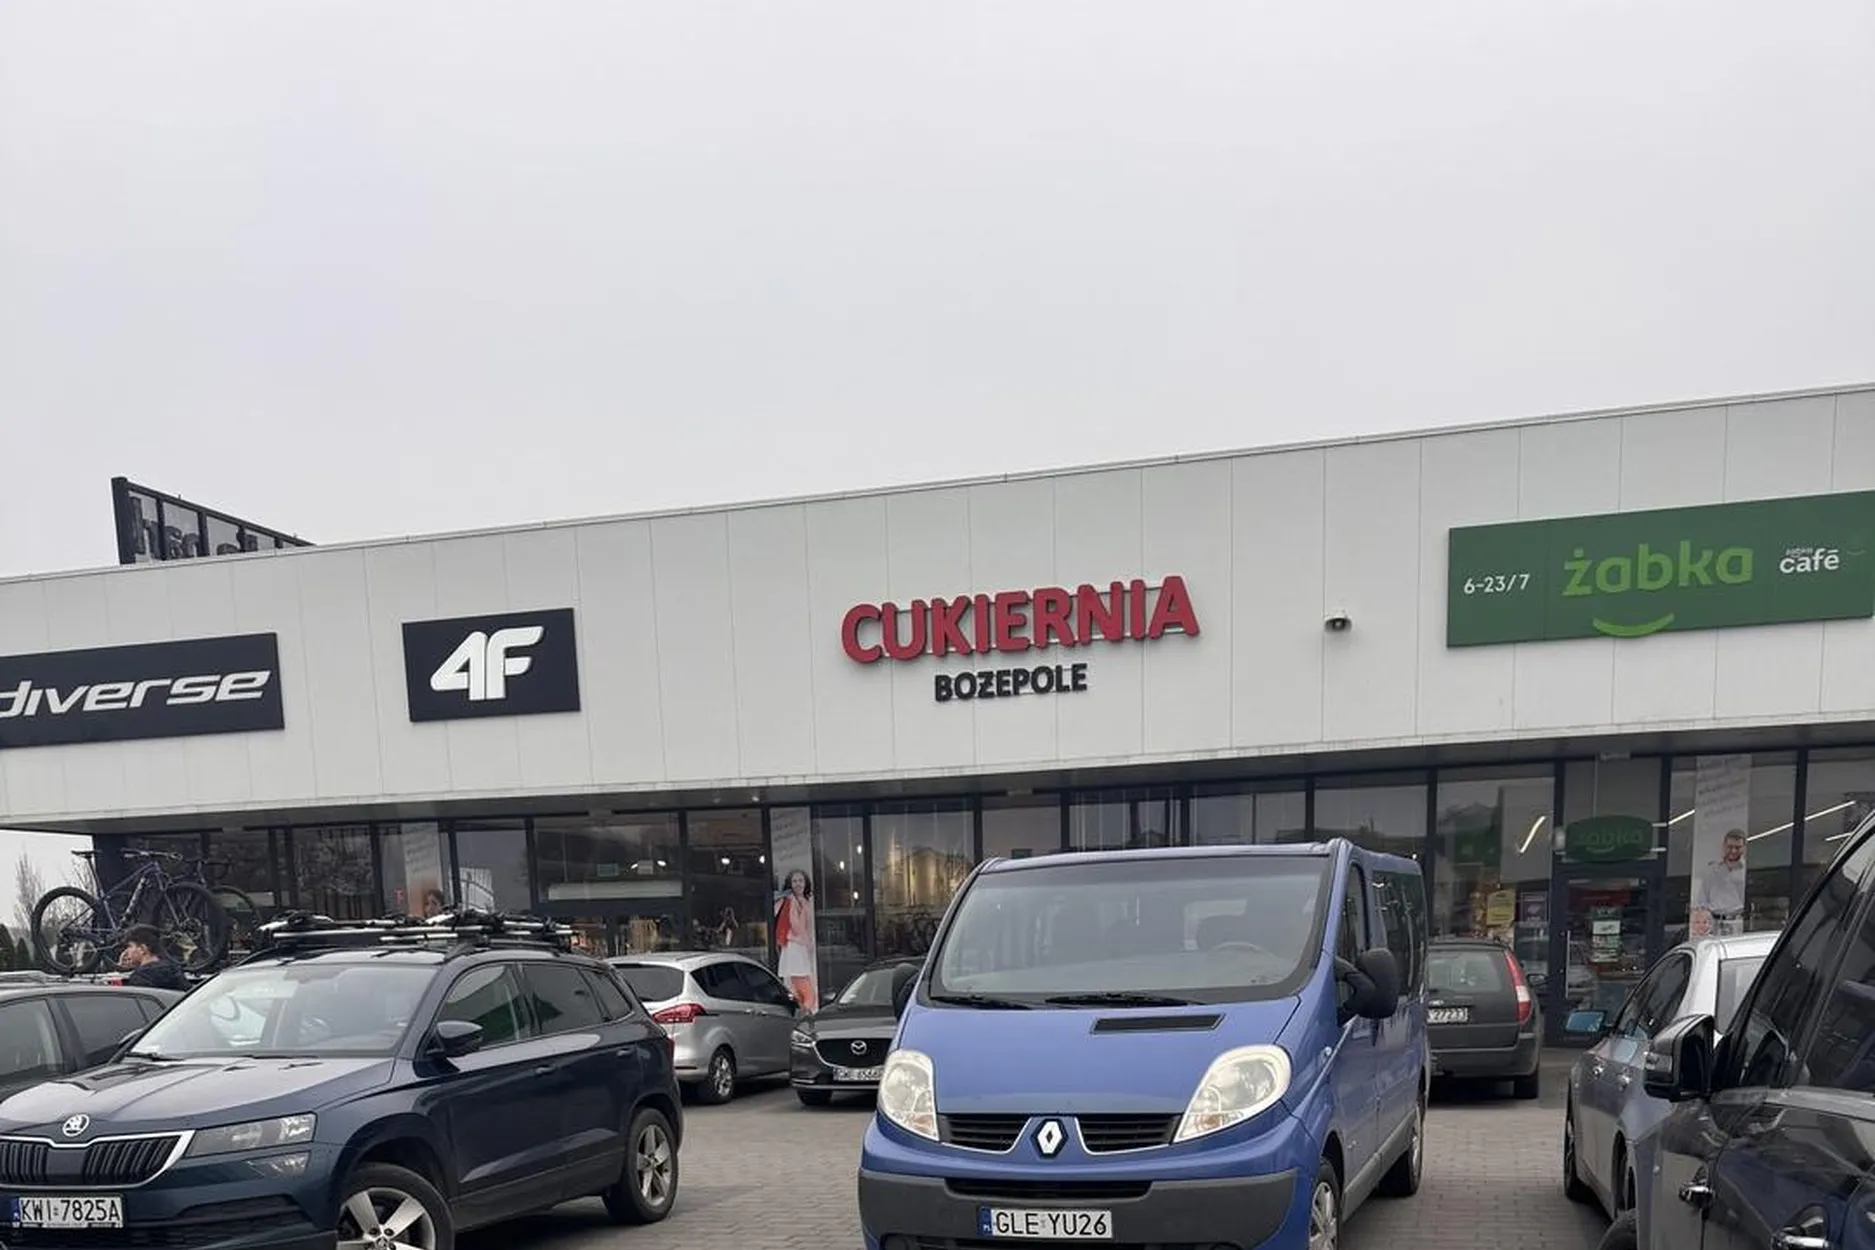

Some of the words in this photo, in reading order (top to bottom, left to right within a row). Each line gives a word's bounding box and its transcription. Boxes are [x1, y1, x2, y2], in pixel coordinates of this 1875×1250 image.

[1464, 574, 1530, 594] 6-23/7
[1563, 540, 1754, 596] żabka
[841, 575, 1200, 664] CUKIERNIA
[430, 626, 544, 701] 4F
[0, 670, 271, 718] diverse
[21, 1199, 52, 1222] KWI
[60, 1199, 121, 1222] 7825A
[996, 1211, 1040, 1236] GLE
[1048, 1213, 1107, 1236] YU26
